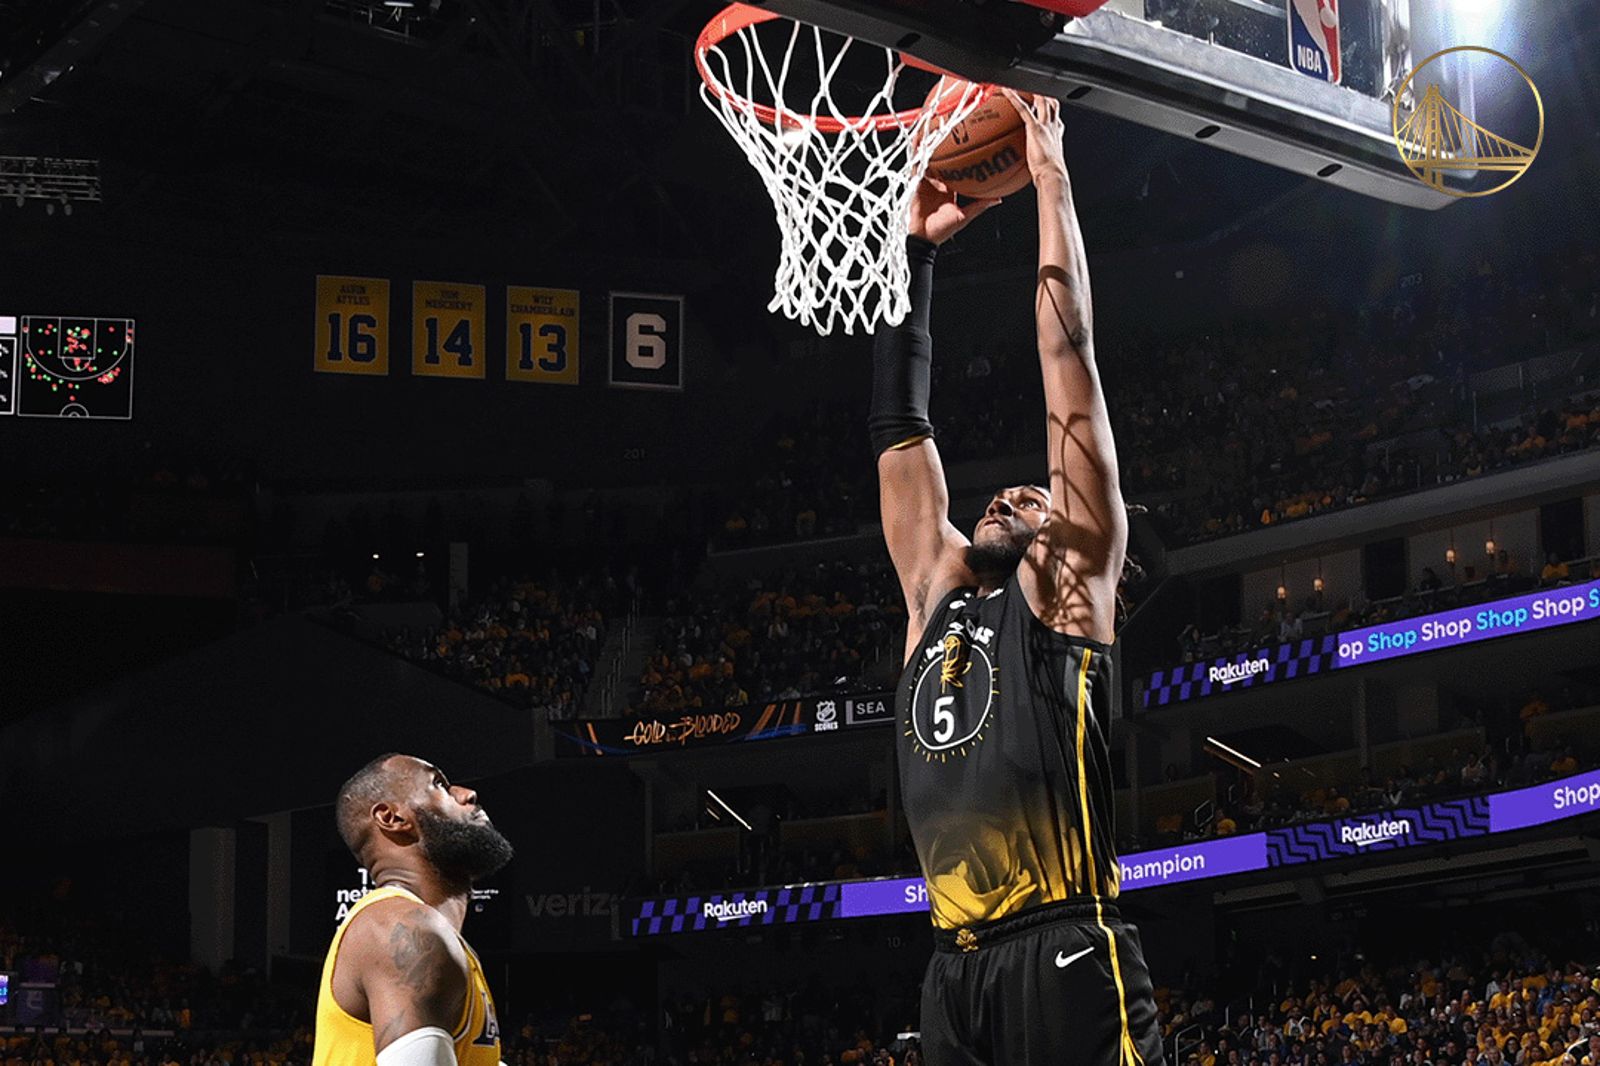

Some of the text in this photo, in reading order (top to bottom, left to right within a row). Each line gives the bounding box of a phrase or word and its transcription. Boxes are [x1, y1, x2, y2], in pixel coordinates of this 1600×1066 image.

[1297, 44, 1323, 74] NBA
[327, 312, 377, 363] 16
[425, 317, 473, 366] 14
[519, 322, 567, 373] 13
[625, 311, 667, 370] 6
[623, 447, 646, 460] 201
[1367, 629, 1417, 652] Shop
[1421, 618, 1472, 641] Shop
[1476, 607, 1528, 630] Shop
[1532, 596, 1585, 619] Shop
[1588, 588, 1600, 608] S
[1208, 657, 1270, 684] Rakuten
[856, 701, 886, 715] SEA
[933, 696, 955, 744] 5
[624, 712, 741, 745] GOLD BLOODED
[814, 721, 839, 732] SCORES
[1553, 783, 1600, 809] Shop
[1341, 819, 1410, 847] Rakuten
[1120, 853, 1205, 882] hampion
[904, 884, 929, 903] Sh
[703, 899, 768, 921] Rakuten
